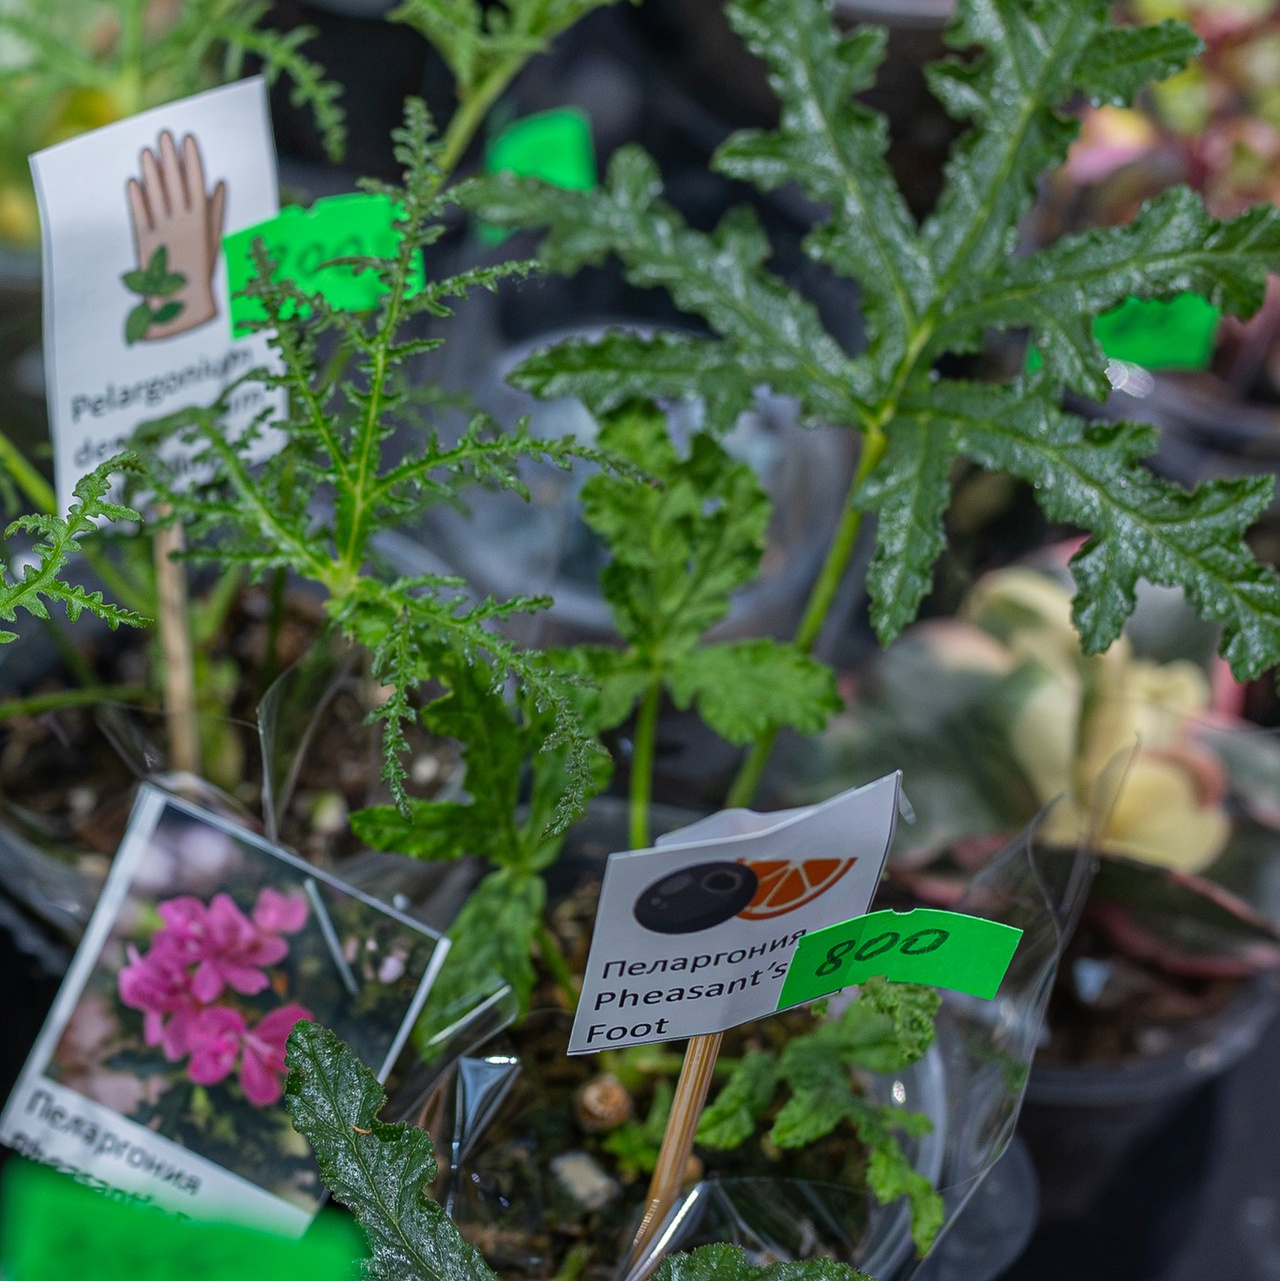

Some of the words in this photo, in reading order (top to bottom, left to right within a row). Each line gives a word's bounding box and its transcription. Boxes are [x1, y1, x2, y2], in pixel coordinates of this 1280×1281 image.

[602, 928, 807, 980] Пеларгония
[814, 928, 951, 977] 800
[594, 961, 790, 1012] Pheasant's
[586, 1017, 670, 1044] Foot
[23, 1087, 203, 1197] Пеларгония
